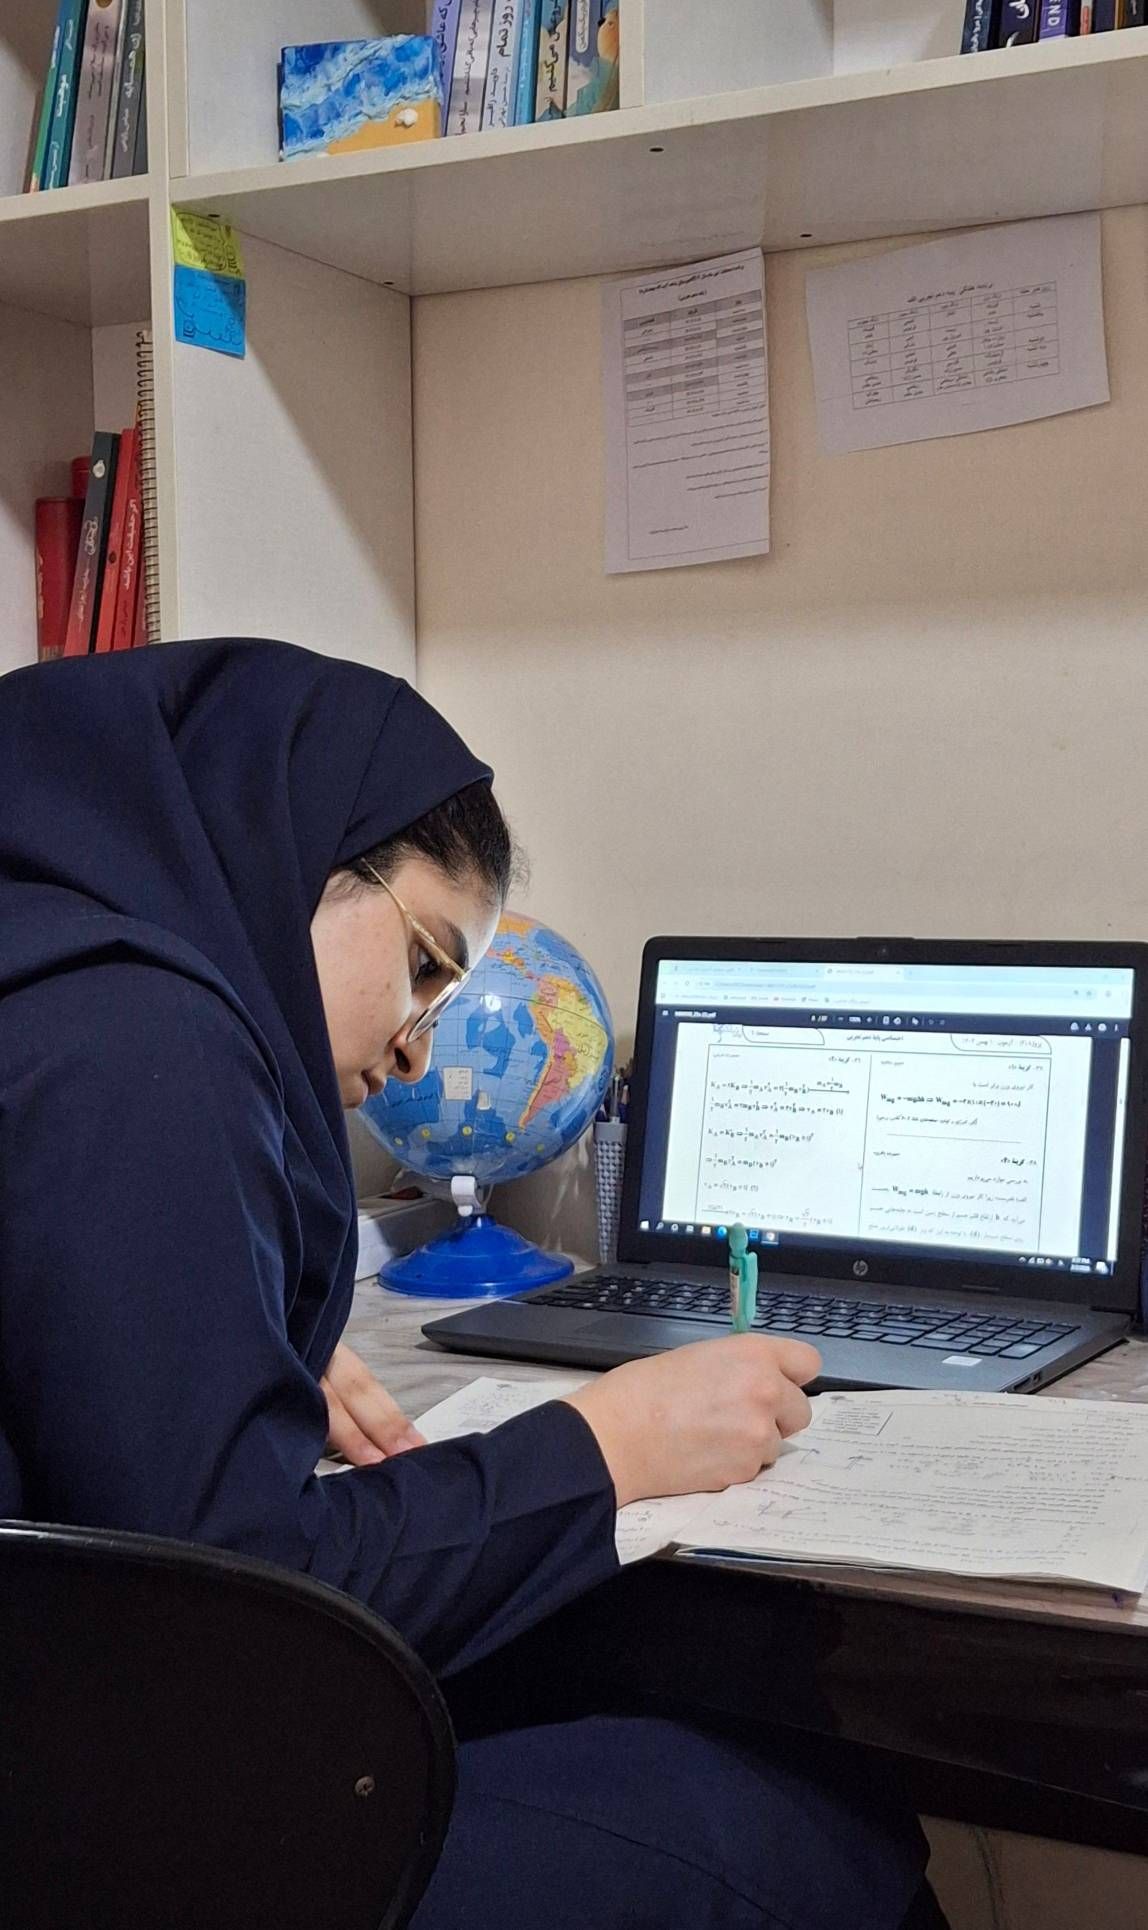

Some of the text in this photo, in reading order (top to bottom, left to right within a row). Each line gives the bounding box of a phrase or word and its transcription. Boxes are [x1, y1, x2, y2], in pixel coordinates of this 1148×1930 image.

[436, 6, 449, 53] که عاشق
[496, 5, 515, 58] روز تمام
[124, 50, 138, 98] همسایه
[122, 498, 139, 590] اگر حقیقت این باشد
